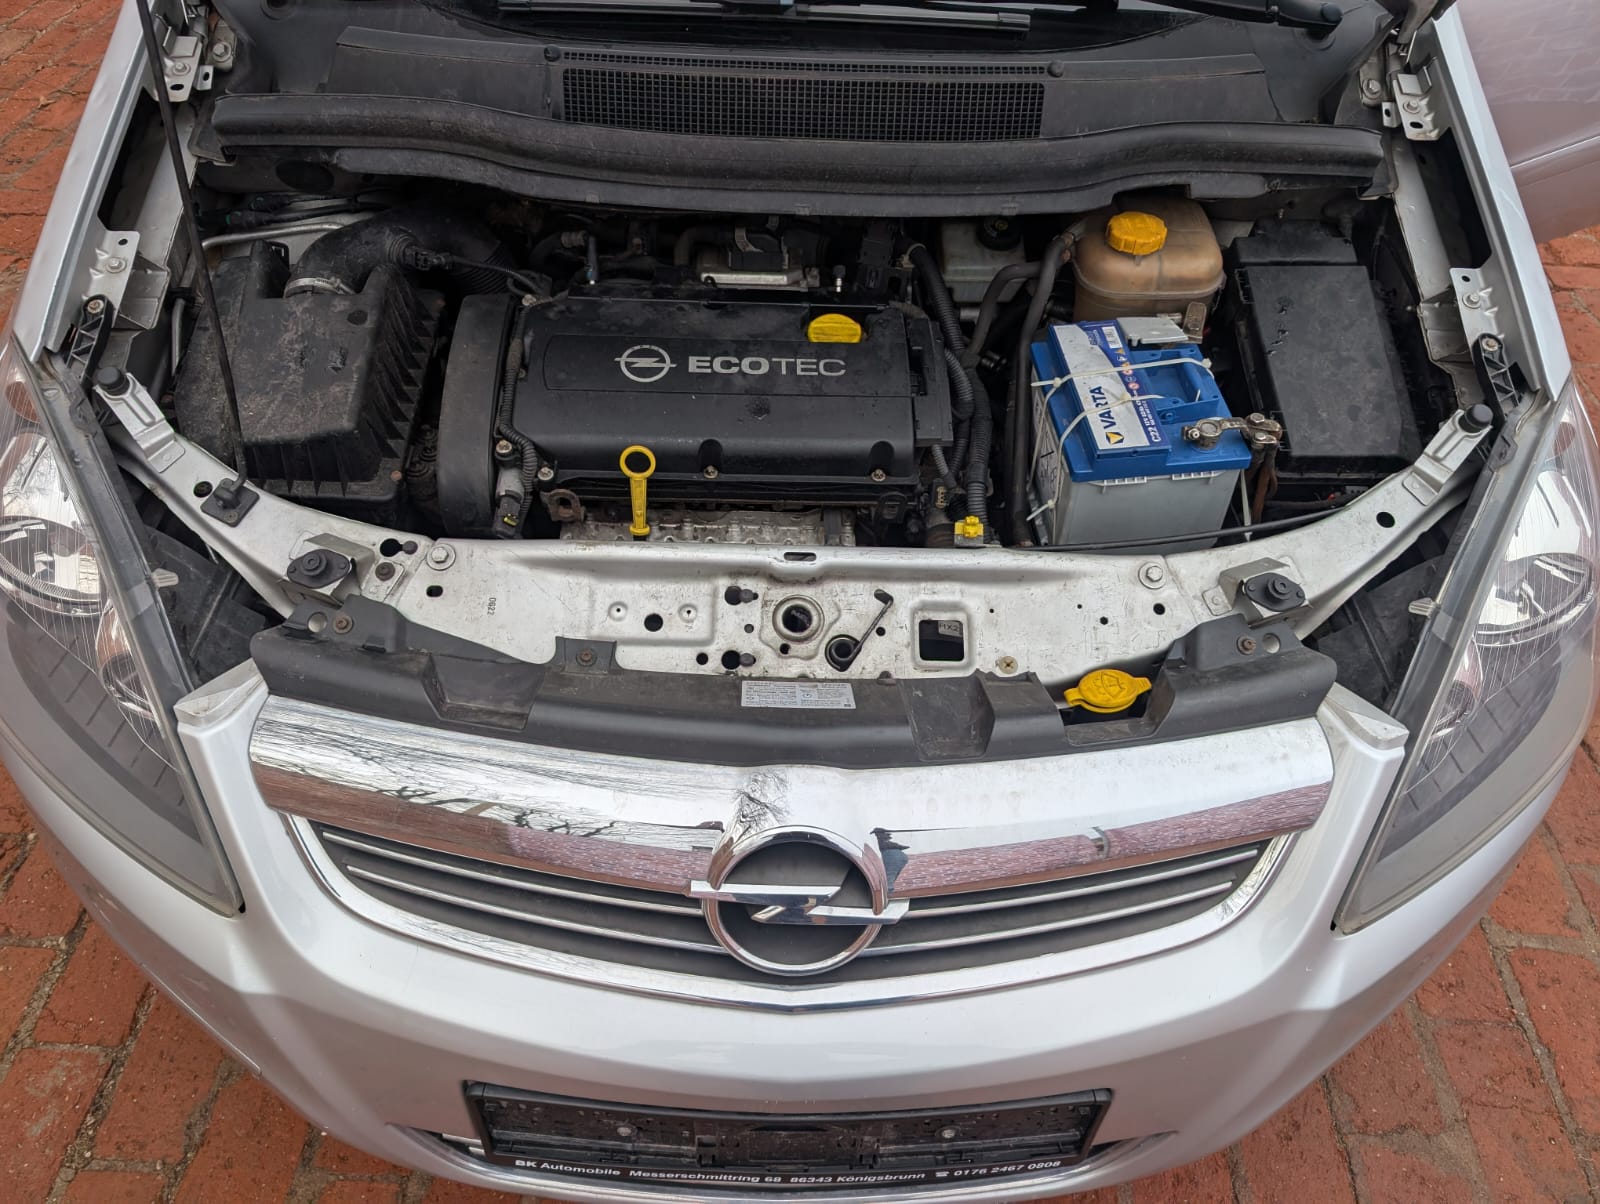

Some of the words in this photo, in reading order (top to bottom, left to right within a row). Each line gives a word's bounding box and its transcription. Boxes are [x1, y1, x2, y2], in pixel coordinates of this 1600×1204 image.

[688, 355, 847, 377] ECOTEC
[1089, 385, 1117, 430] VARTA
[1147, 426, 1162, 442] C22
[515, 1159, 537, 1168] BK
[540, 1161, 621, 1176] Automobile
[629, 1170, 761, 1183] Messerschmittring
[836, 1173, 926, 1184] Königsbrunn
[953, 1168, 988, 1177] 0176
[990, 1164, 1025, 1174] 2467
